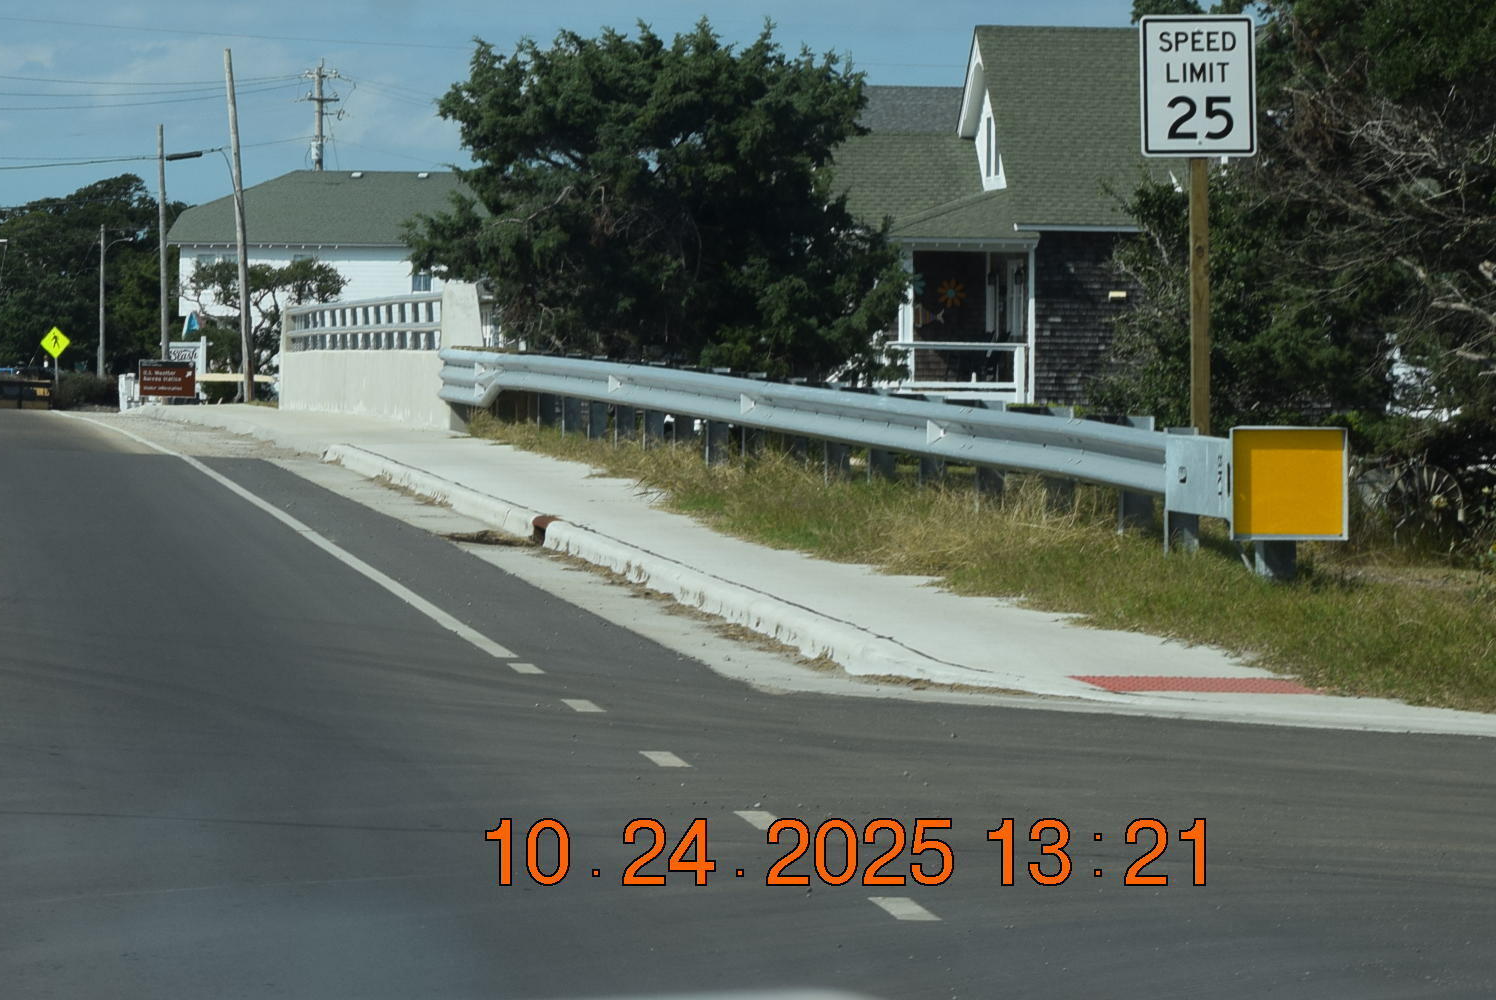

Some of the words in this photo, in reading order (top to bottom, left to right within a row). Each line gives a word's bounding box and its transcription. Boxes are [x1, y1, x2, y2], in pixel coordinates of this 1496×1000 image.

[1159, 31, 1237, 52] SPEED
[1166, 62, 1230, 83] LIMIT
[1167, 95, 1235, 140] 25
